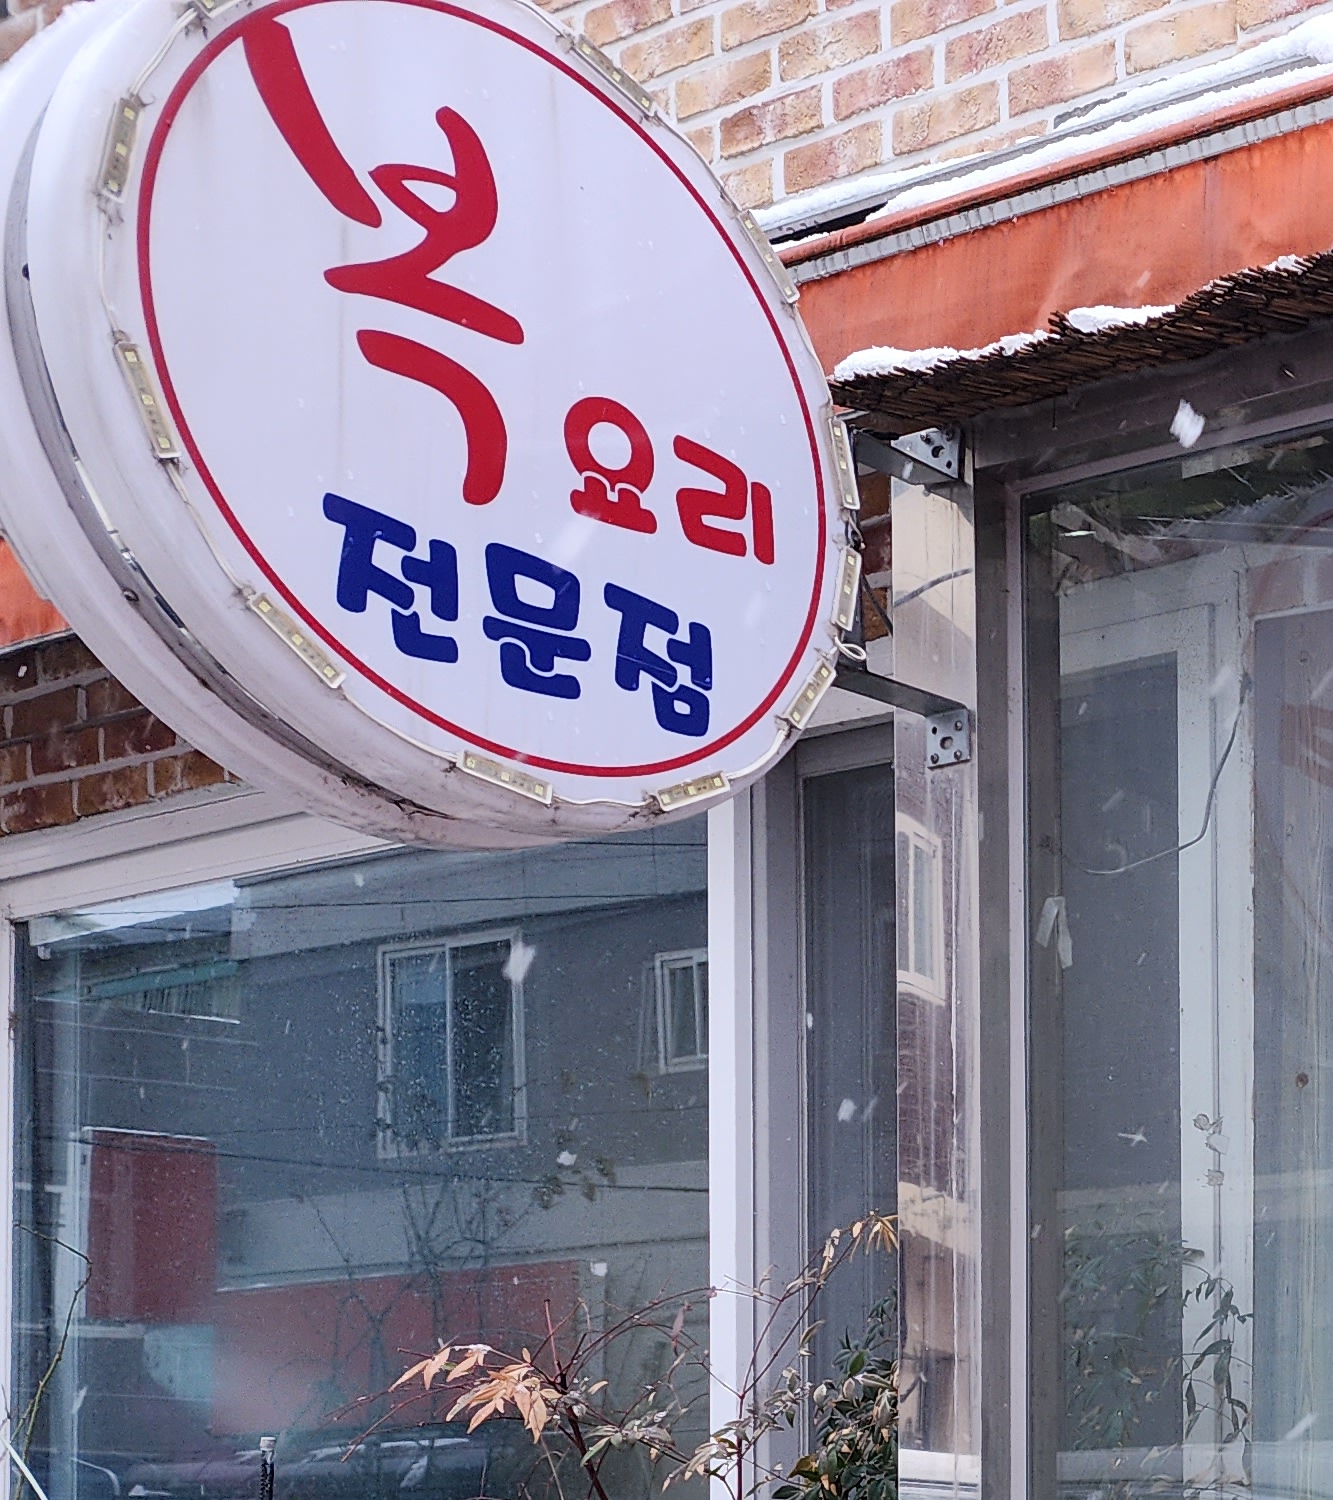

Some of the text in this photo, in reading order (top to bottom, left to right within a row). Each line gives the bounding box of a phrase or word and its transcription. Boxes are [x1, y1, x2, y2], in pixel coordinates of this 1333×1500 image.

[242, 16, 776, 566] 복 요리
[322, 492, 713, 737] 전문점
